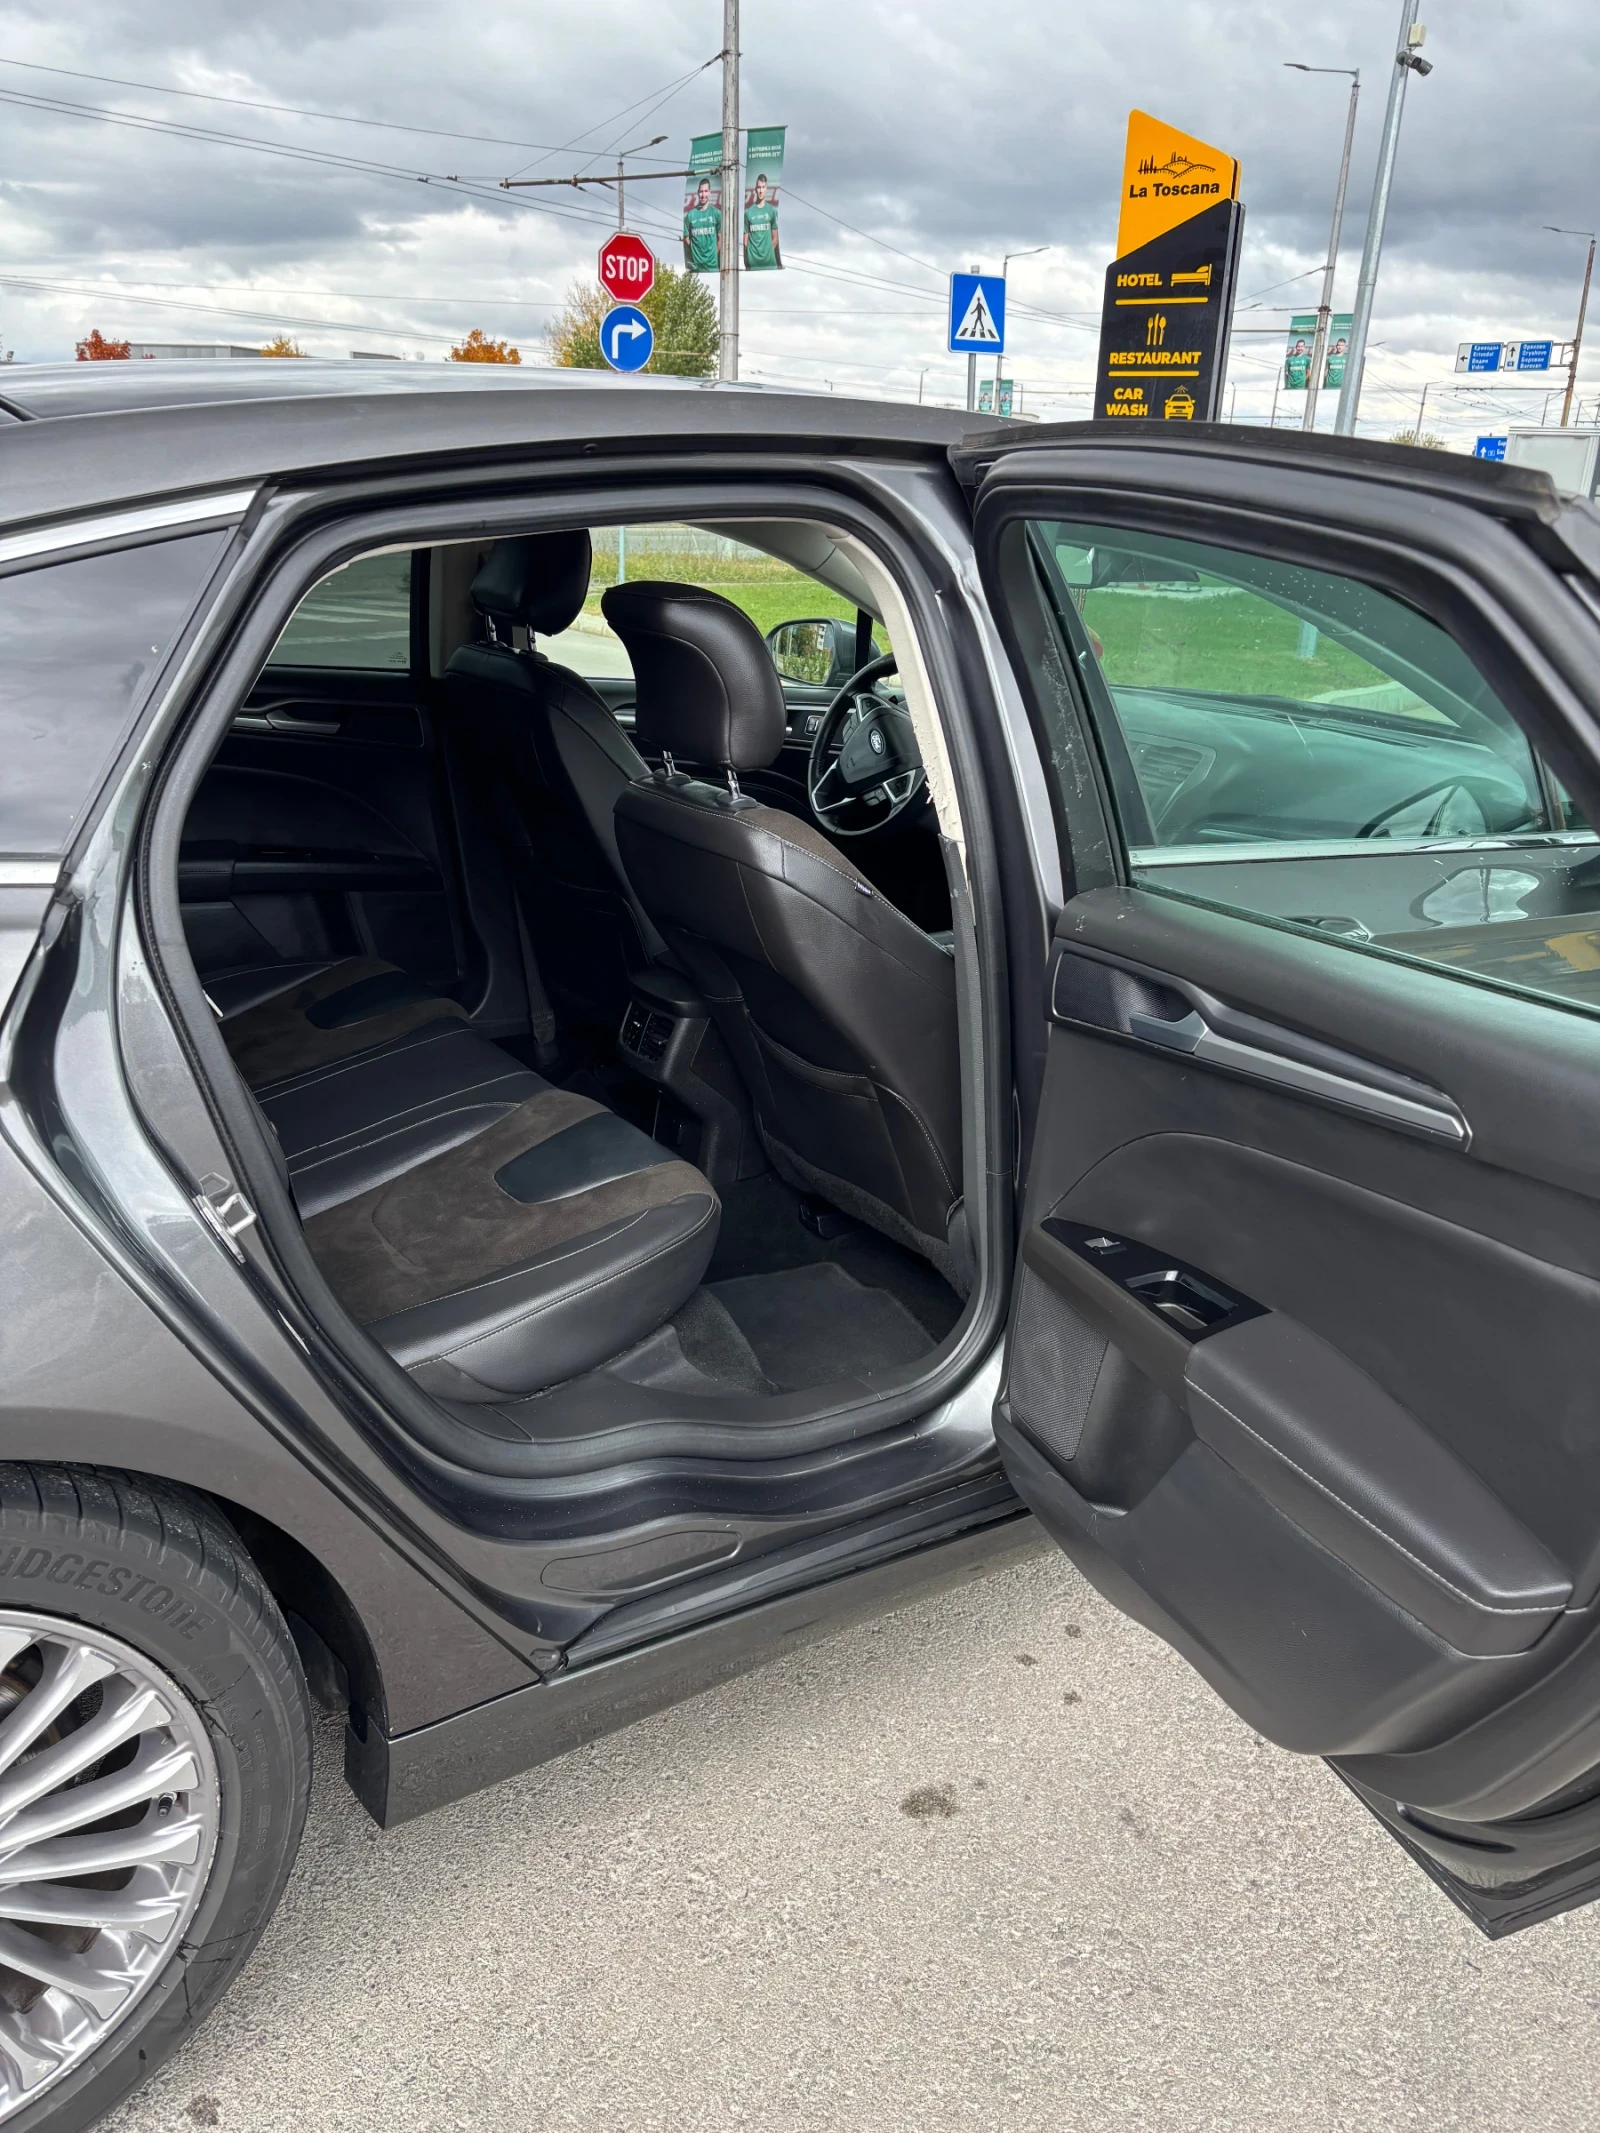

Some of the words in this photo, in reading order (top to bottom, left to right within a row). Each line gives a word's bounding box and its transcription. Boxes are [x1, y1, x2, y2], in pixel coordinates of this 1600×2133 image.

[1129, 184, 1147, 198] La
[1152, 182, 1220, 197] Toscana
[691, 226, 716, 236] WINBET
[749, 222, 770, 232] WINBET
[605, 254, 650, 282] STOP
[1116, 273, 1163, 287] HOTEL
[1109, 352, 1202, 365] RESTAURANT
[1113, 387, 1144, 400] CAR
[1106, 403, 1149, 416] WASH
